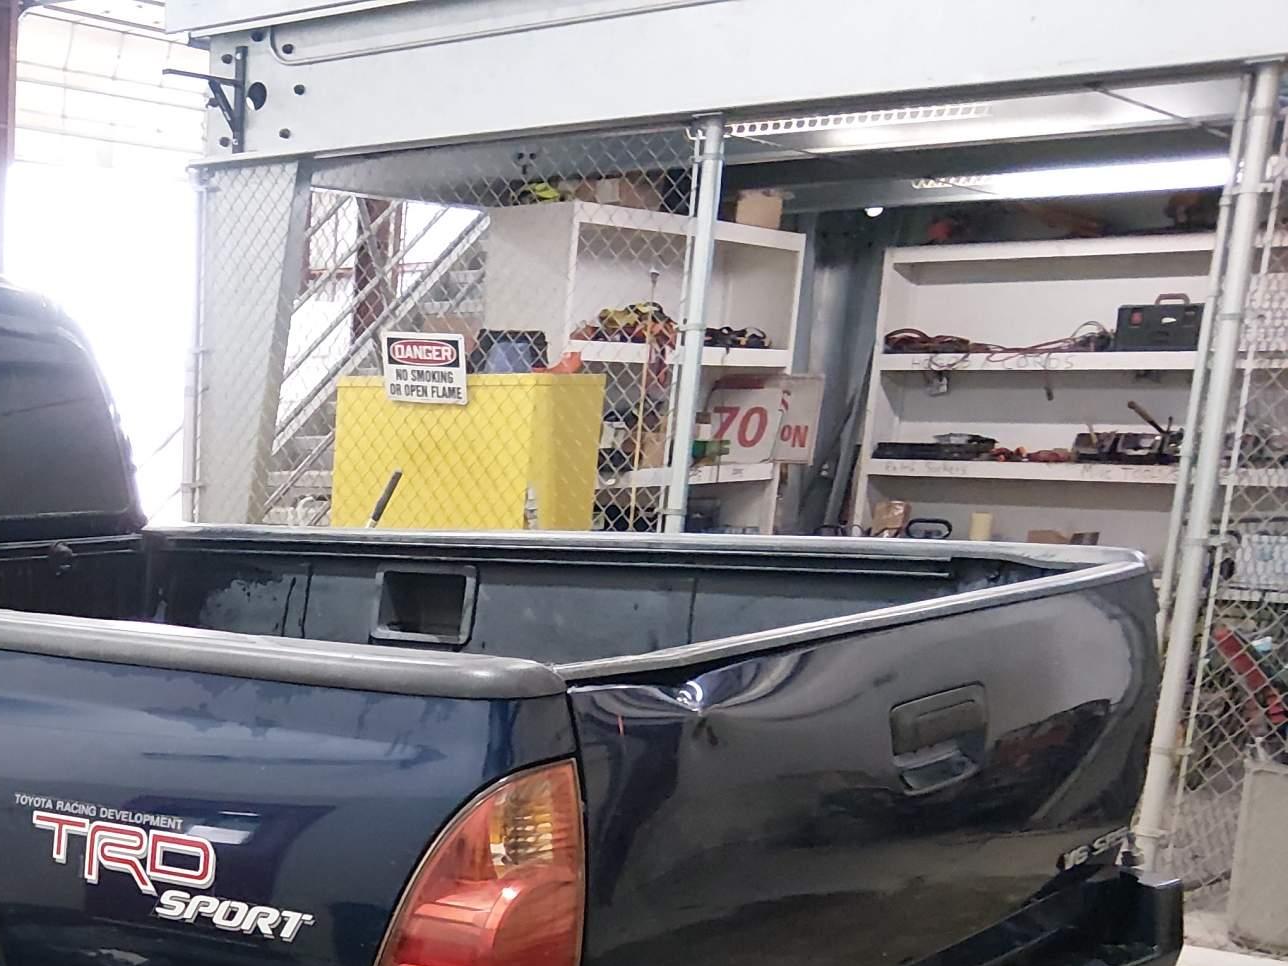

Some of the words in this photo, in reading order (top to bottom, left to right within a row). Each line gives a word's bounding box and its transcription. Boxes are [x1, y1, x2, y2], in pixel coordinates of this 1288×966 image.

[394, 344, 452, 361] DANGER
[389, 383, 402, 396] OR
[404, 384, 429, 398] OPEN
[431, 385, 463, 400] FLAME
[395, 368, 409, 382] NO
[410, 369, 454, 384] SMOKING
[713, 406, 768, 448] 70
[14, 793, 53, 810] TOYOTA
[56, 800, 97, 818] RACING
[100, 807, 184, 831] DEVELOPMENT
[32, 810, 217, 896] TRD
[155, 890, 316, 942] SPORT
